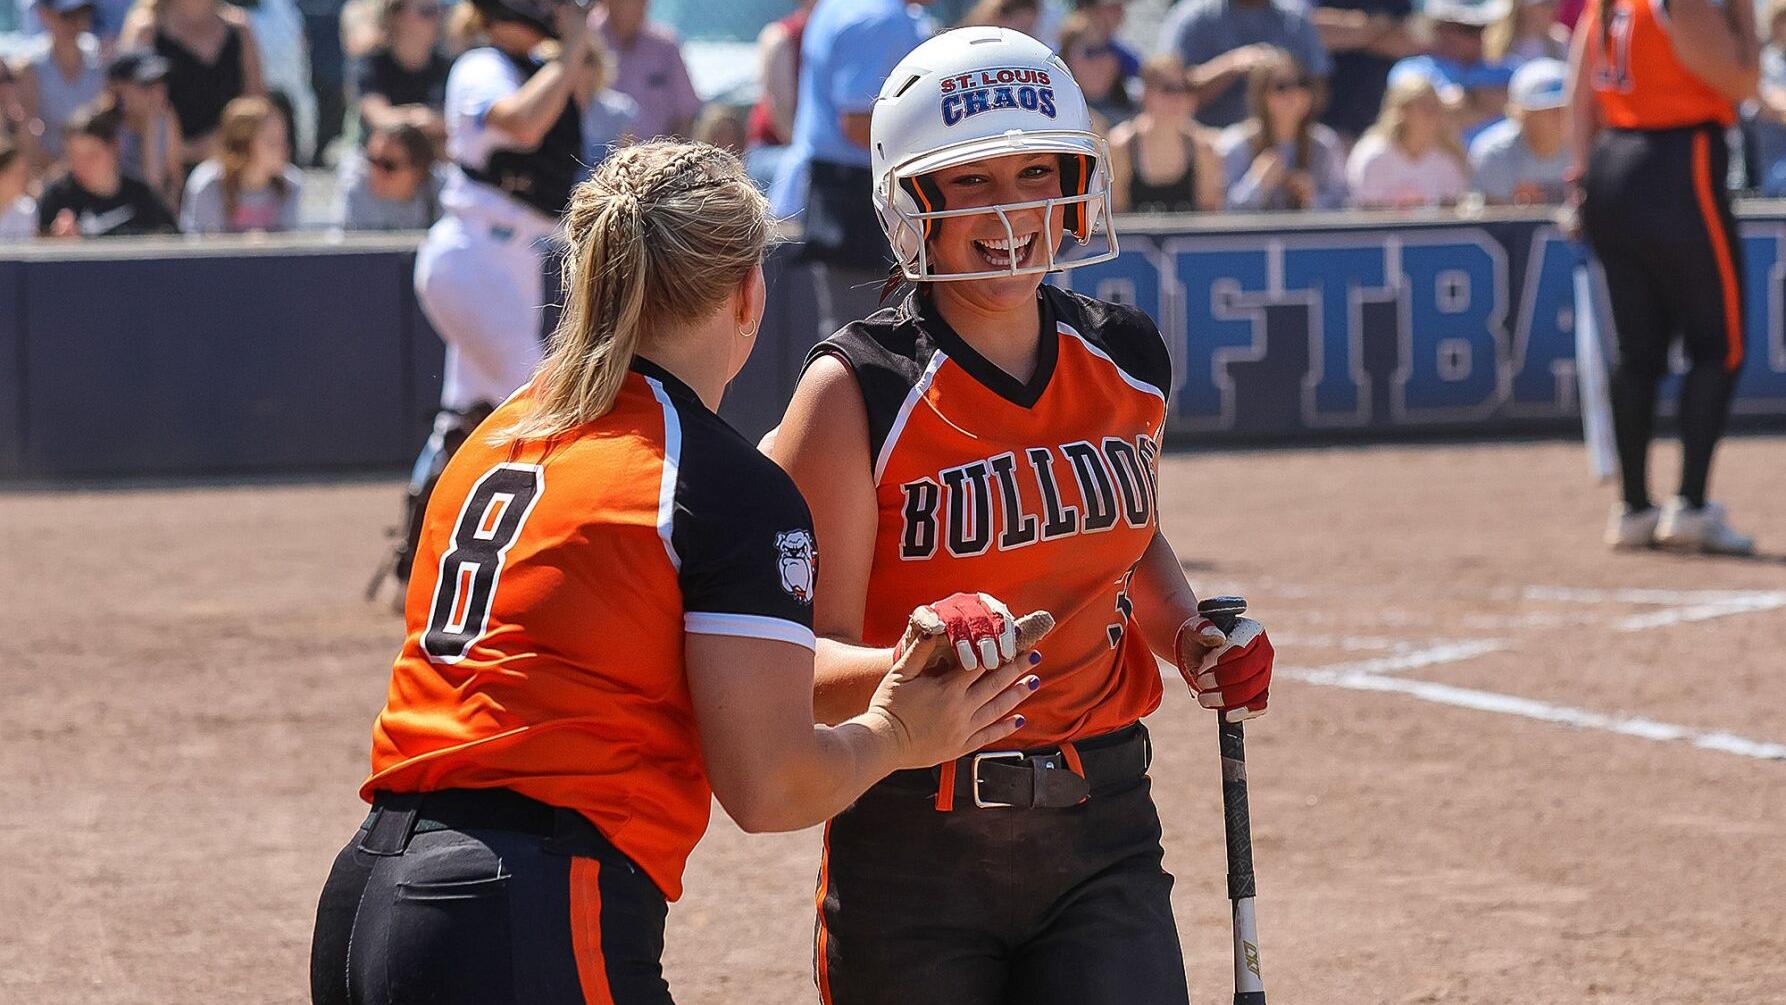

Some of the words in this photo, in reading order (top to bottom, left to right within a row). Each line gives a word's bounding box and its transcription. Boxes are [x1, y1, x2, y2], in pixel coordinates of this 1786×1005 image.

[941, 75, 976, 93] ST.
[982, 70, 1050, 85] LOUIS
[941, 87, 1056, 126] CHAOS
[1052, 221, 1786, 430] FTBA
[419, 462, 546, 664] 8
